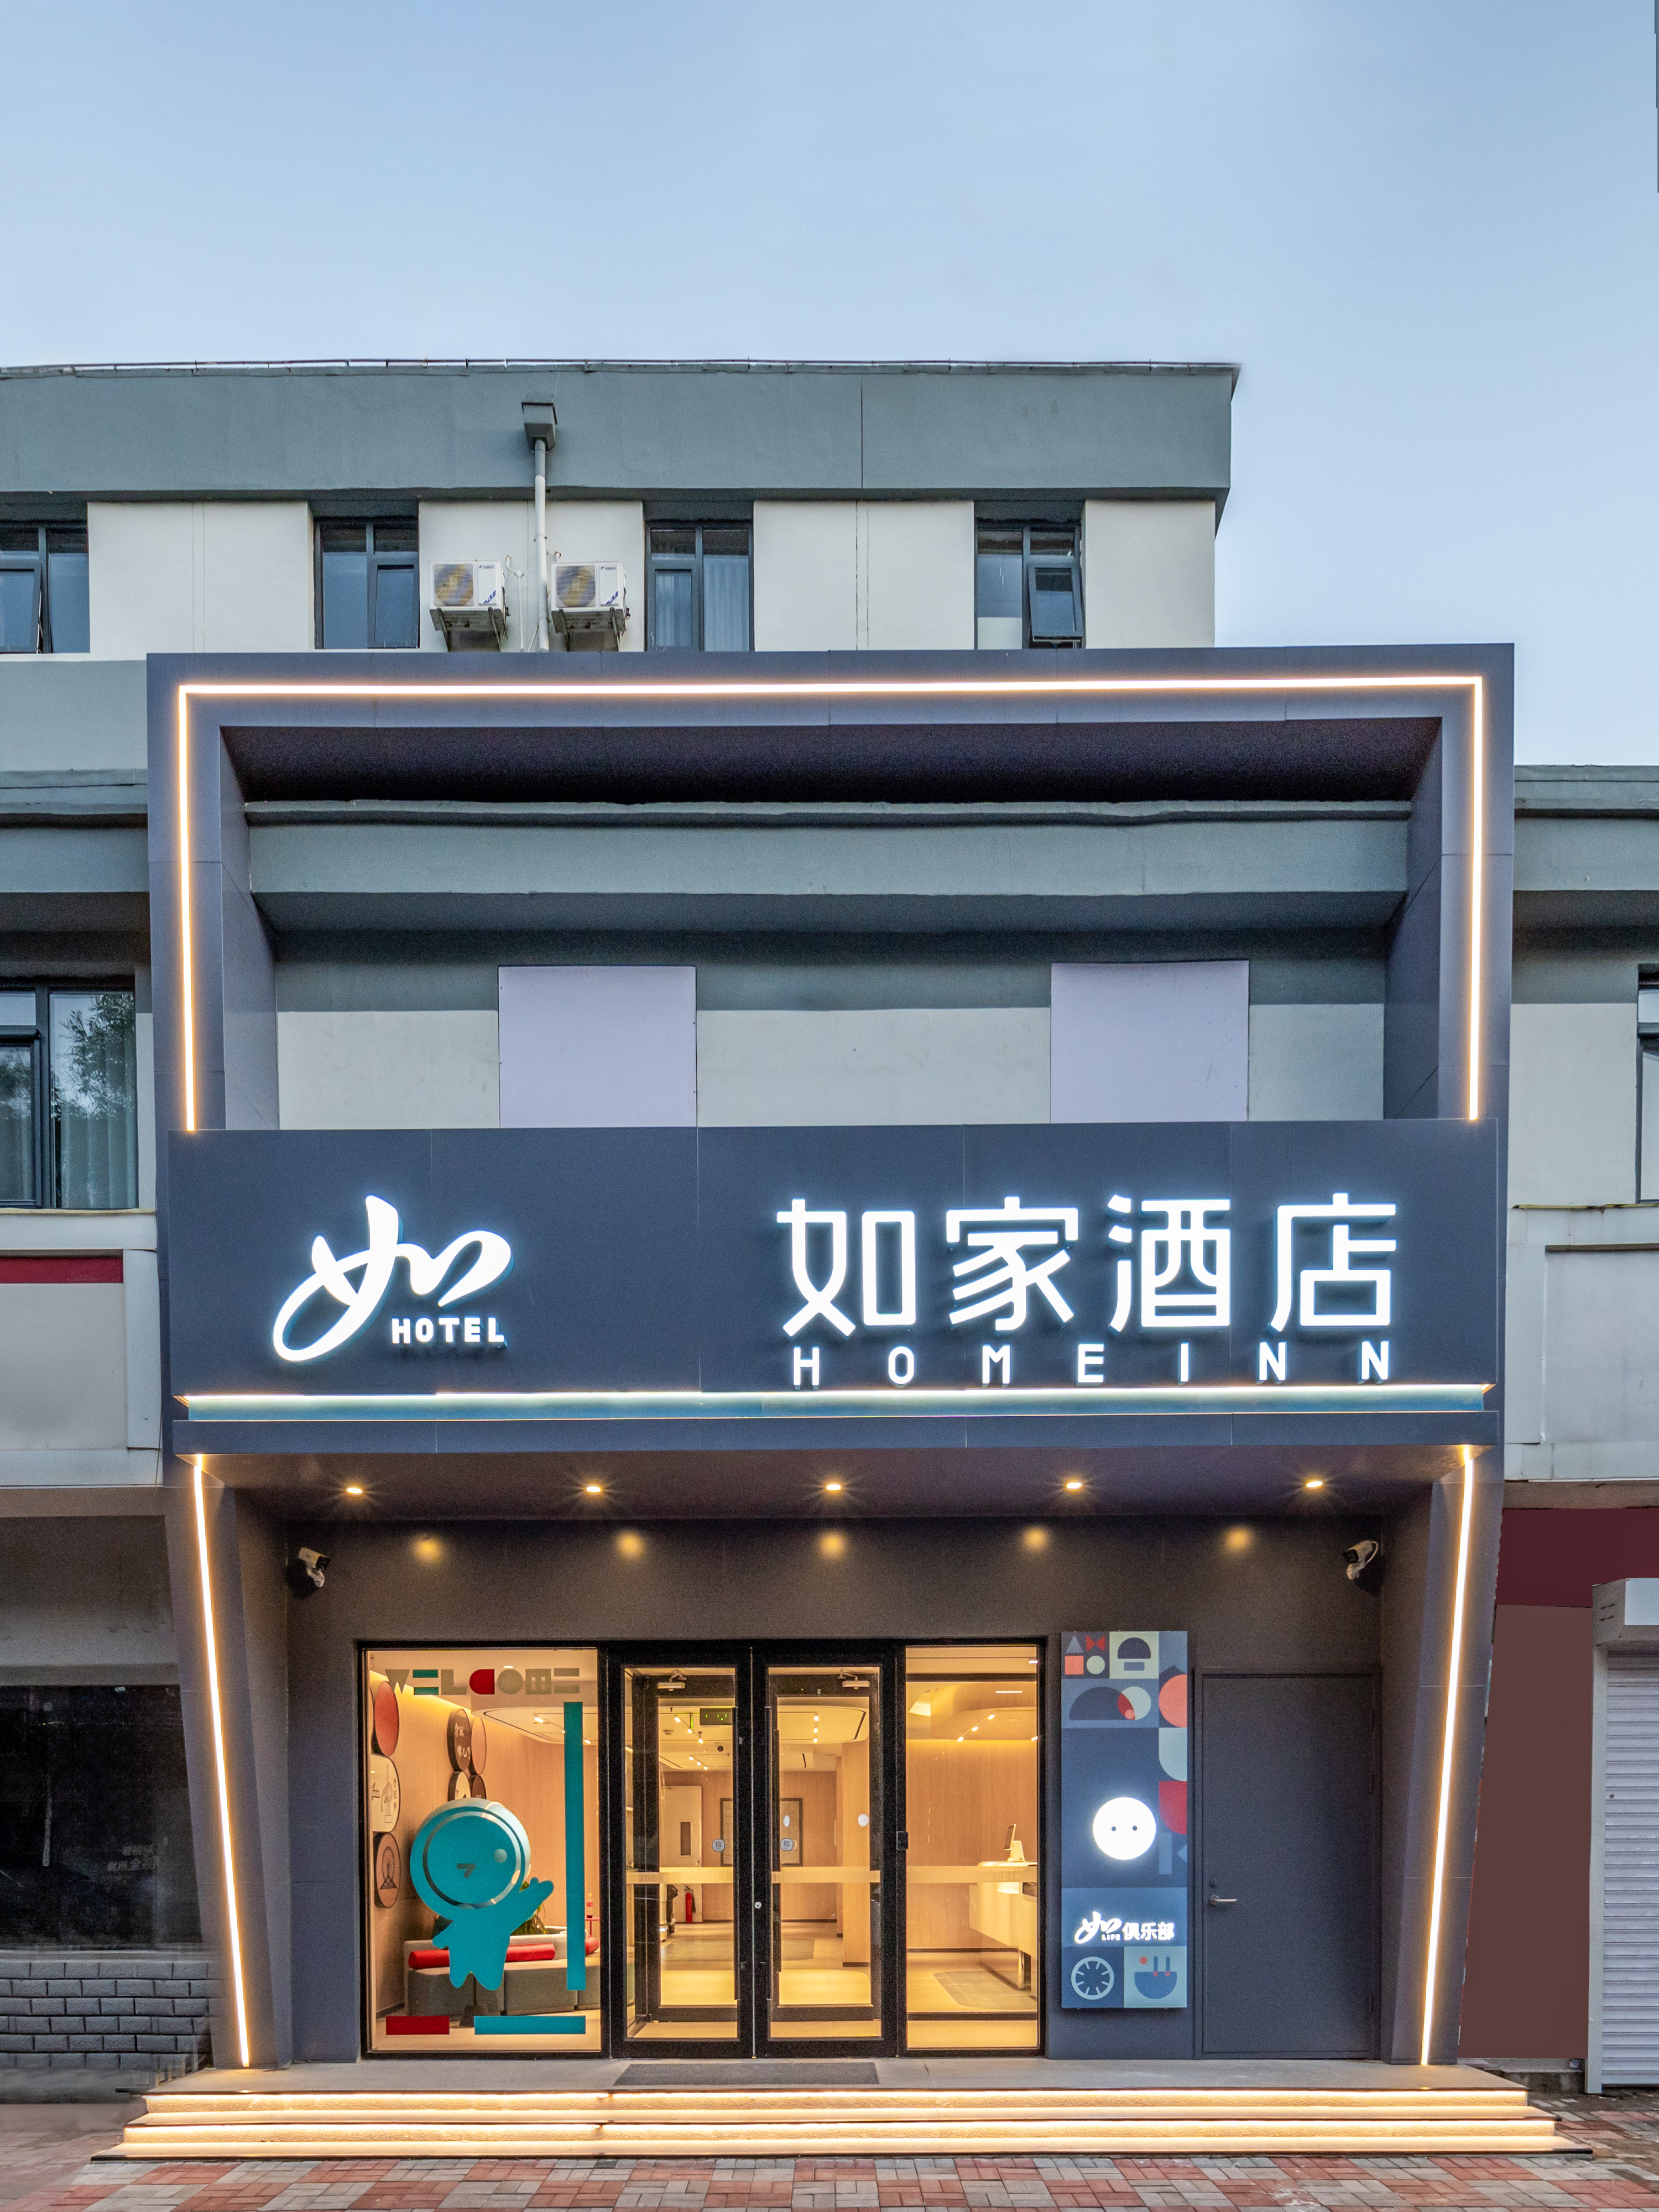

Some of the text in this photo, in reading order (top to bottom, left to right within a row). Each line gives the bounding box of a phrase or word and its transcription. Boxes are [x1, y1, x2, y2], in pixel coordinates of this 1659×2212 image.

[777, 1193, 1396, 1337] 如家酒店
[392, 1317, 506, 1345] HOTEL
[385, 1668, 580, 1695] WELCOME
[1122, 1922, 1176, 1941] 俱乐部
